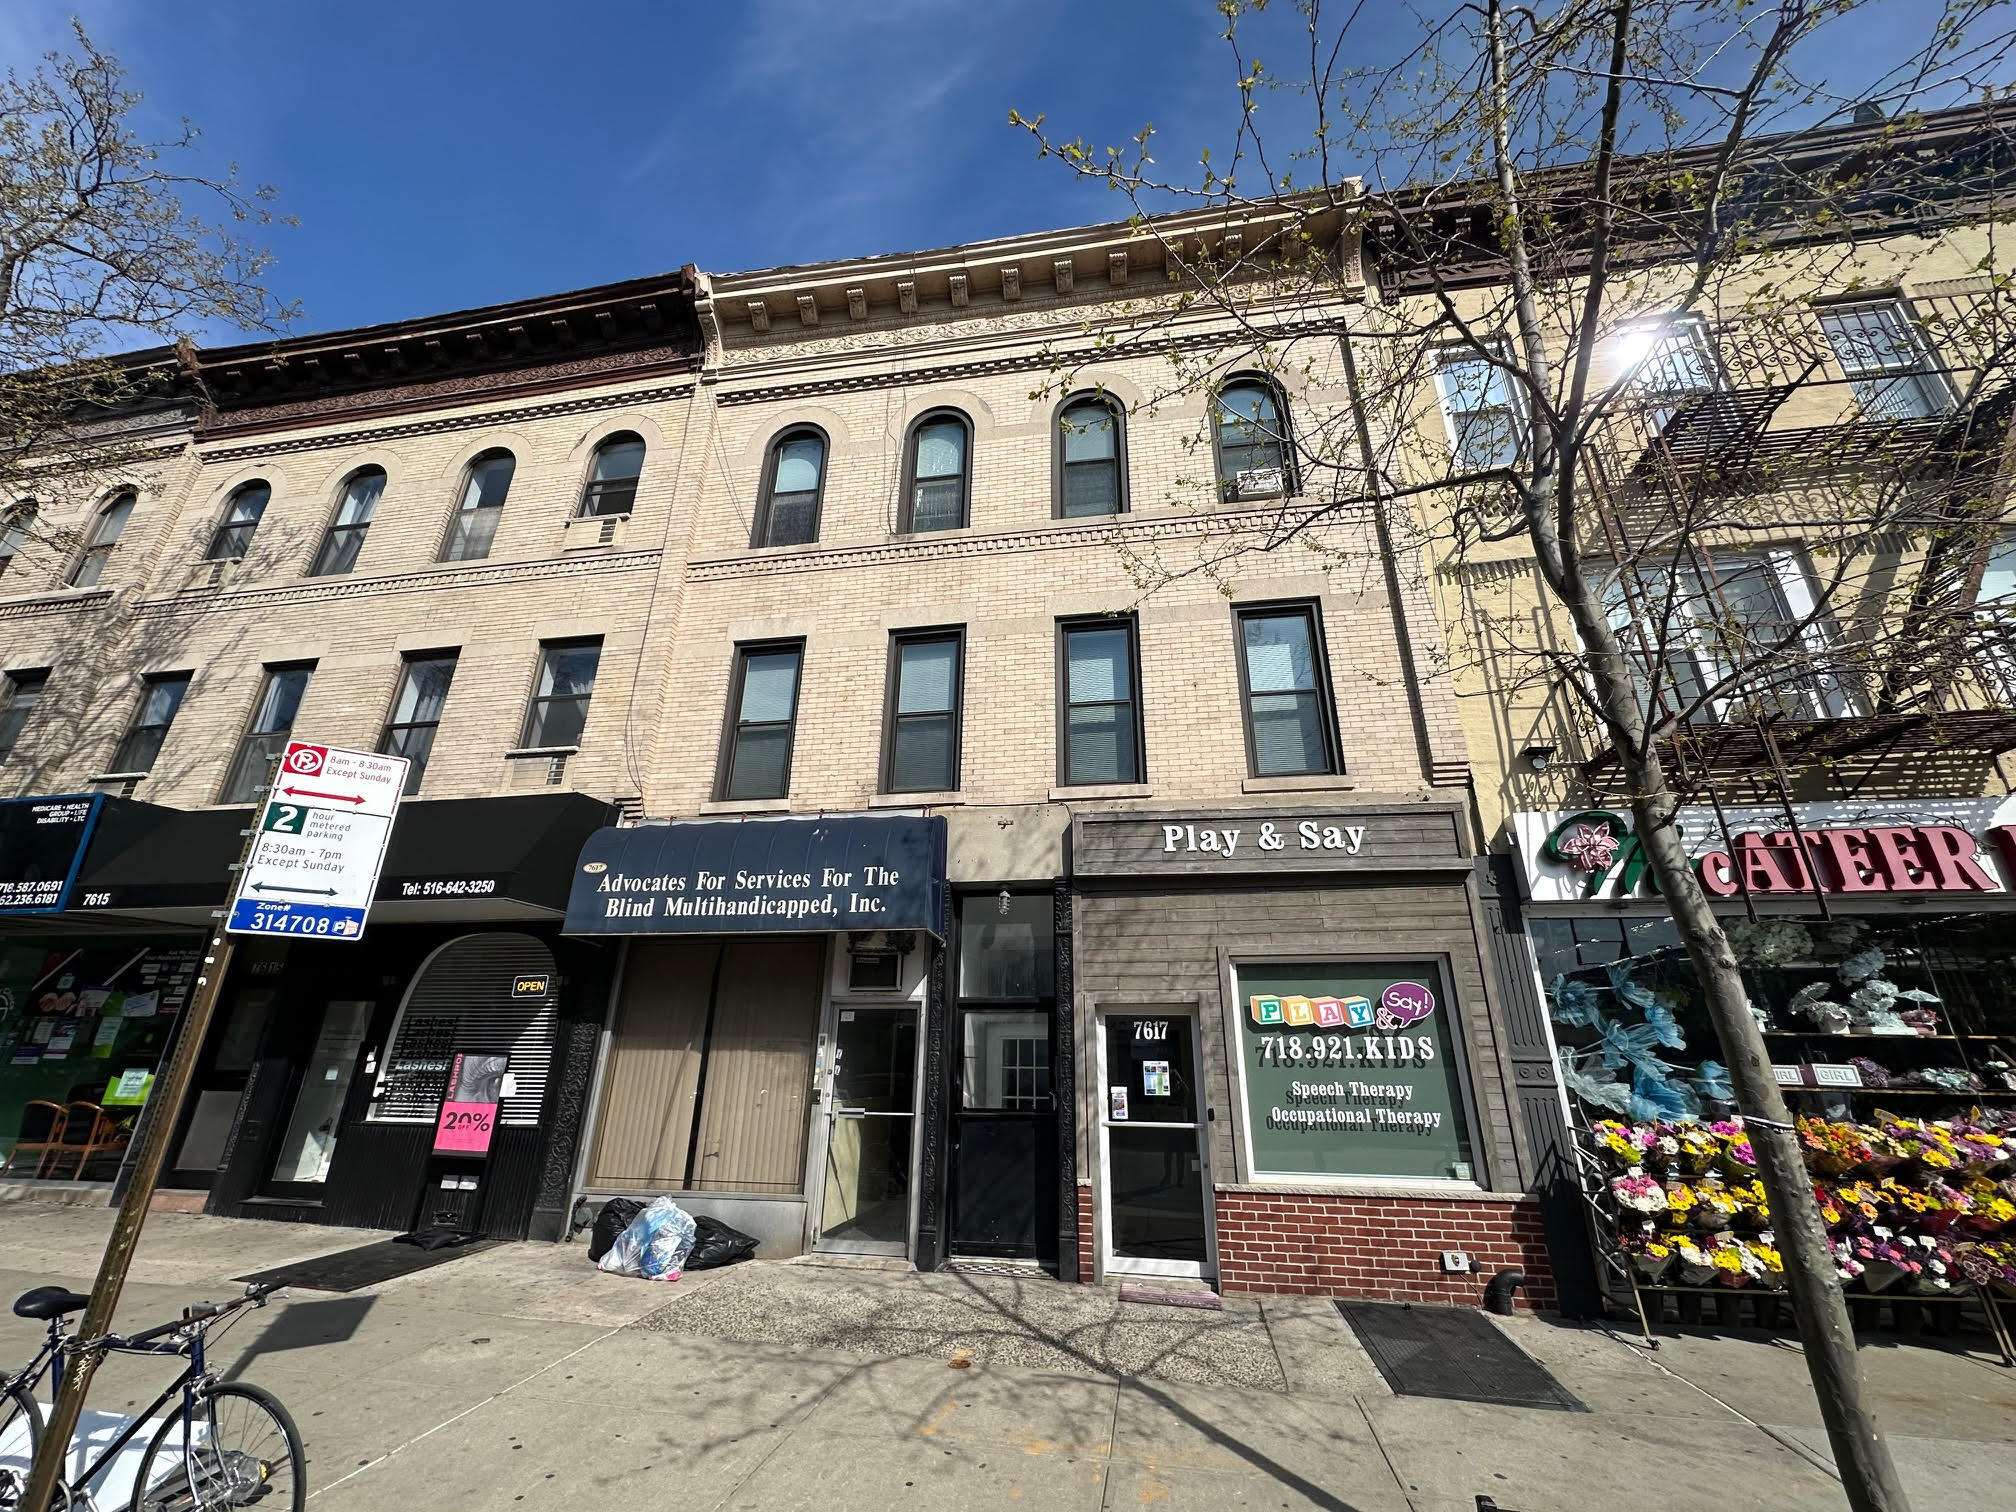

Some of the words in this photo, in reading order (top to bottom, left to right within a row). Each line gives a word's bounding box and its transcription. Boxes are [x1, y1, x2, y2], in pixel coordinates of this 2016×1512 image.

[329, 756, 350, 766] 8am
[358, 760, 392, 772] 8:30am
[326, 767, 357, 779] Except
[359, 771, 392, 784] Sunday
[32, 804, 62, 812] MEDICARE
[312, 812, 335, 821] hour
[37, 816, 69, 824] DISABILITY
[272, 806, 298, 832] 2
[309, 822, 351, 832] metered
[307, 830, 343, 841] parking
[1162, 824, 1241, 858] Play
[1258, 822, 1285, 851] &
[1298, 821, 1366, 854] Say
[261, 842, 306, 856] 8:30am
[319, 848, 342, 861] 7pm
[257, 855, 298, 869] Except
[302, 860, 345, 874] Sunday
[402, 882, 421, 895] Tel:
[423, 880, 495, 895] 516-642-3250
[597, 873, 686, 892] Advocates
[695, 871, 726, 891] For
[735, 869, 811, 889] Services
[821, 868, 852, 888] For
[864, 866, 899, 887] The
[83, 893, 111, 906] 7615
[256, 901, 291, 912] Zone#
[604, 897, 655, 917] Blind
[663, 893, 838, 919] Multihandicapped,
[849, 893, 886, 913] Inc.
[251, 913, 330, 934] 314708
[517, 981, 545, 991] OPEN
[1260, 1000, 1371, 1024] PLAY
[1386, 991, 1428, 1016] Say!
[1376, 1008, 1398, 1029] &
[1133, 1021, 1168, 1040] 7617
[1261, 1036, 1435, 1060] 718.921.KIDS
[1775, 1069, 1798, 1080] IRL
[1819, 1069, 1853, 1081] GIRL
[1291, 1081, 1345, 1098] Speech
[1349, 1081, 1413, 1100] Therapy
[443, 1112, 490, 1132] 20%
[1271, 1106, 1372, 1125] Occupational
[1376, 1108, 1442, 1128] Therapy
